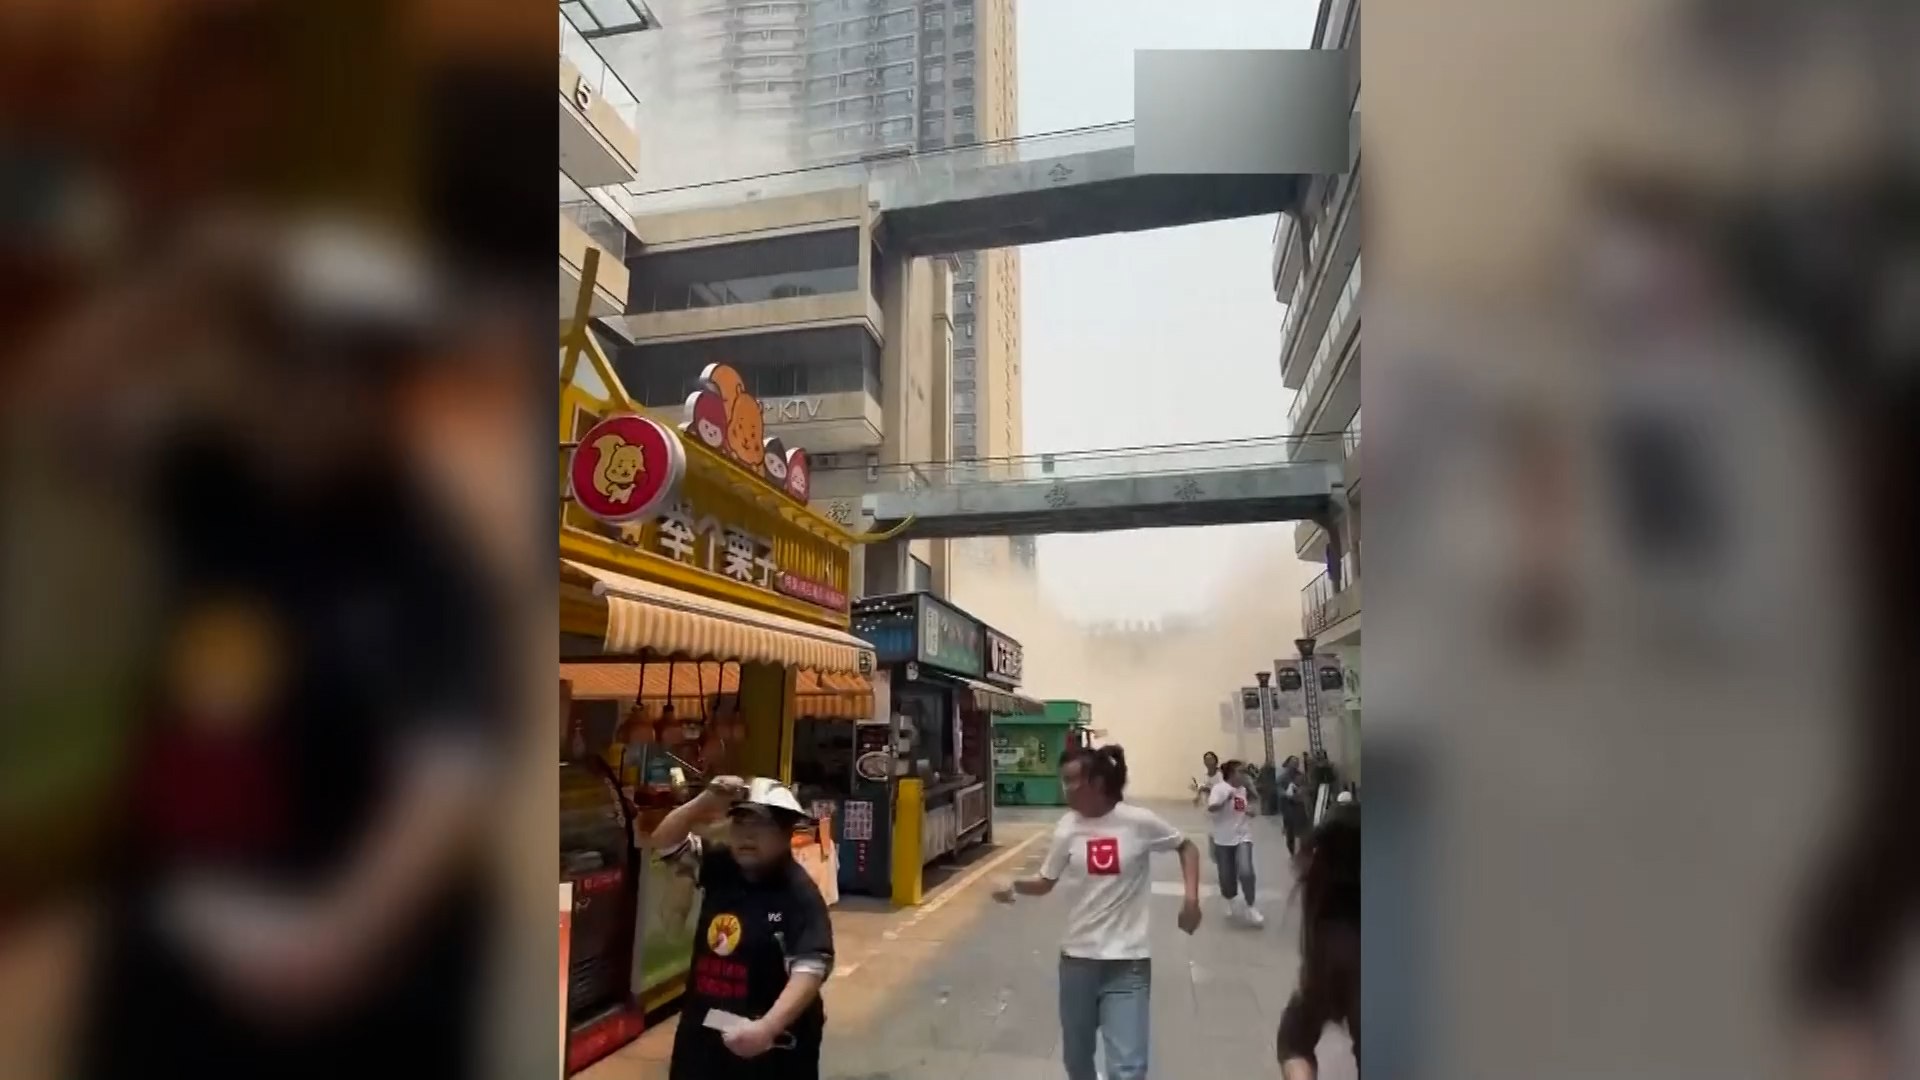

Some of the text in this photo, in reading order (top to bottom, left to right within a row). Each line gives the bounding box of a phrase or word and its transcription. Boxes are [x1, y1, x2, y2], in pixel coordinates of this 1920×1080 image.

[778, 398, 822, 419] KTV
[659, 498, 778, 587] 举个栗子
